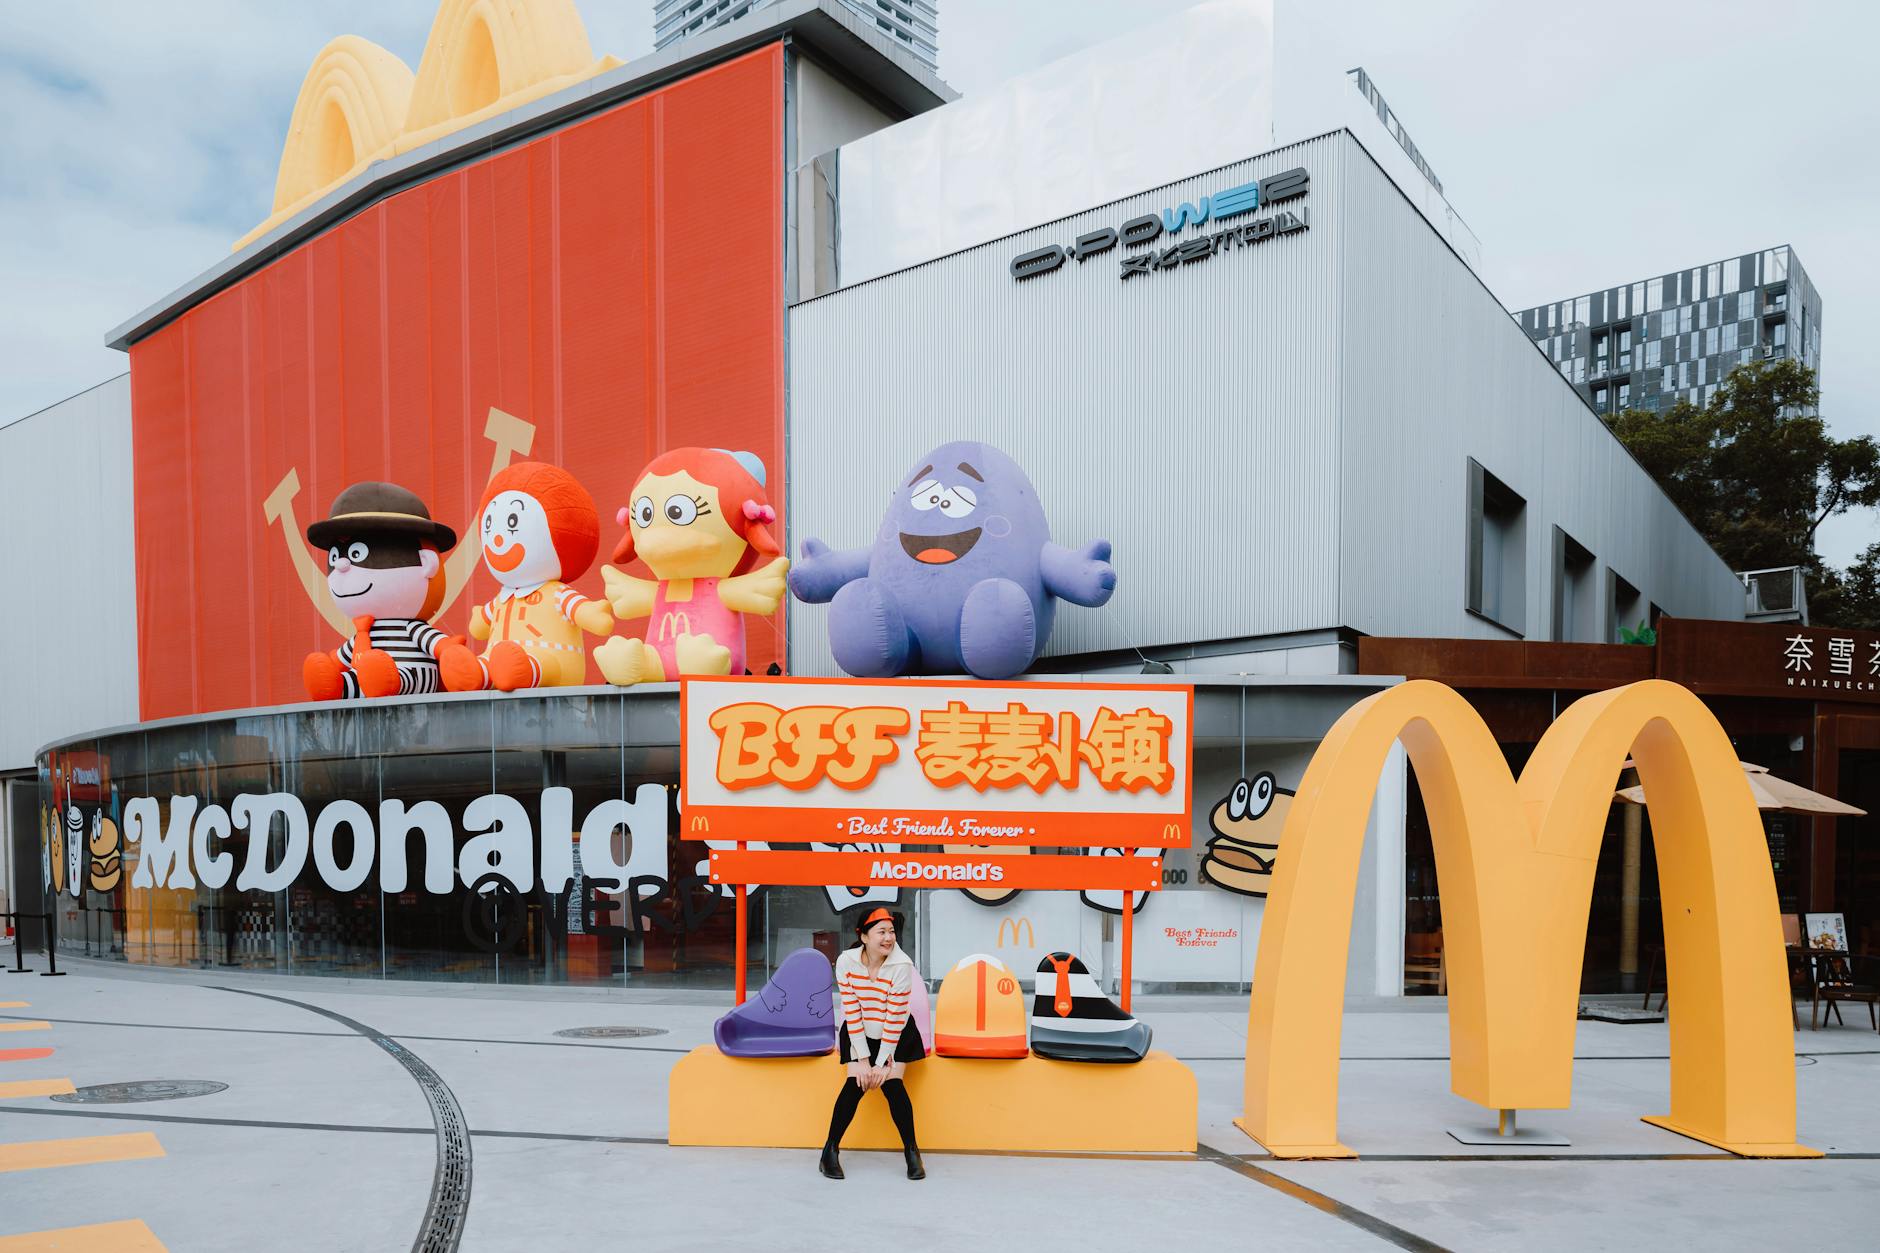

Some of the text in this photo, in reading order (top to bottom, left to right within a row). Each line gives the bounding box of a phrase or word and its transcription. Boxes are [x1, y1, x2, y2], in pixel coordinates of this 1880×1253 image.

[709, 701, 1175, 796] BFF 麦麦小镇
[848, 816, 1025, 838] Best Friends Forever
[870, 861, 1004, 882] McDonald's
[1164, 927, 1238, 938] Best Friends
[1175, 937, 1218, 947] Forever
